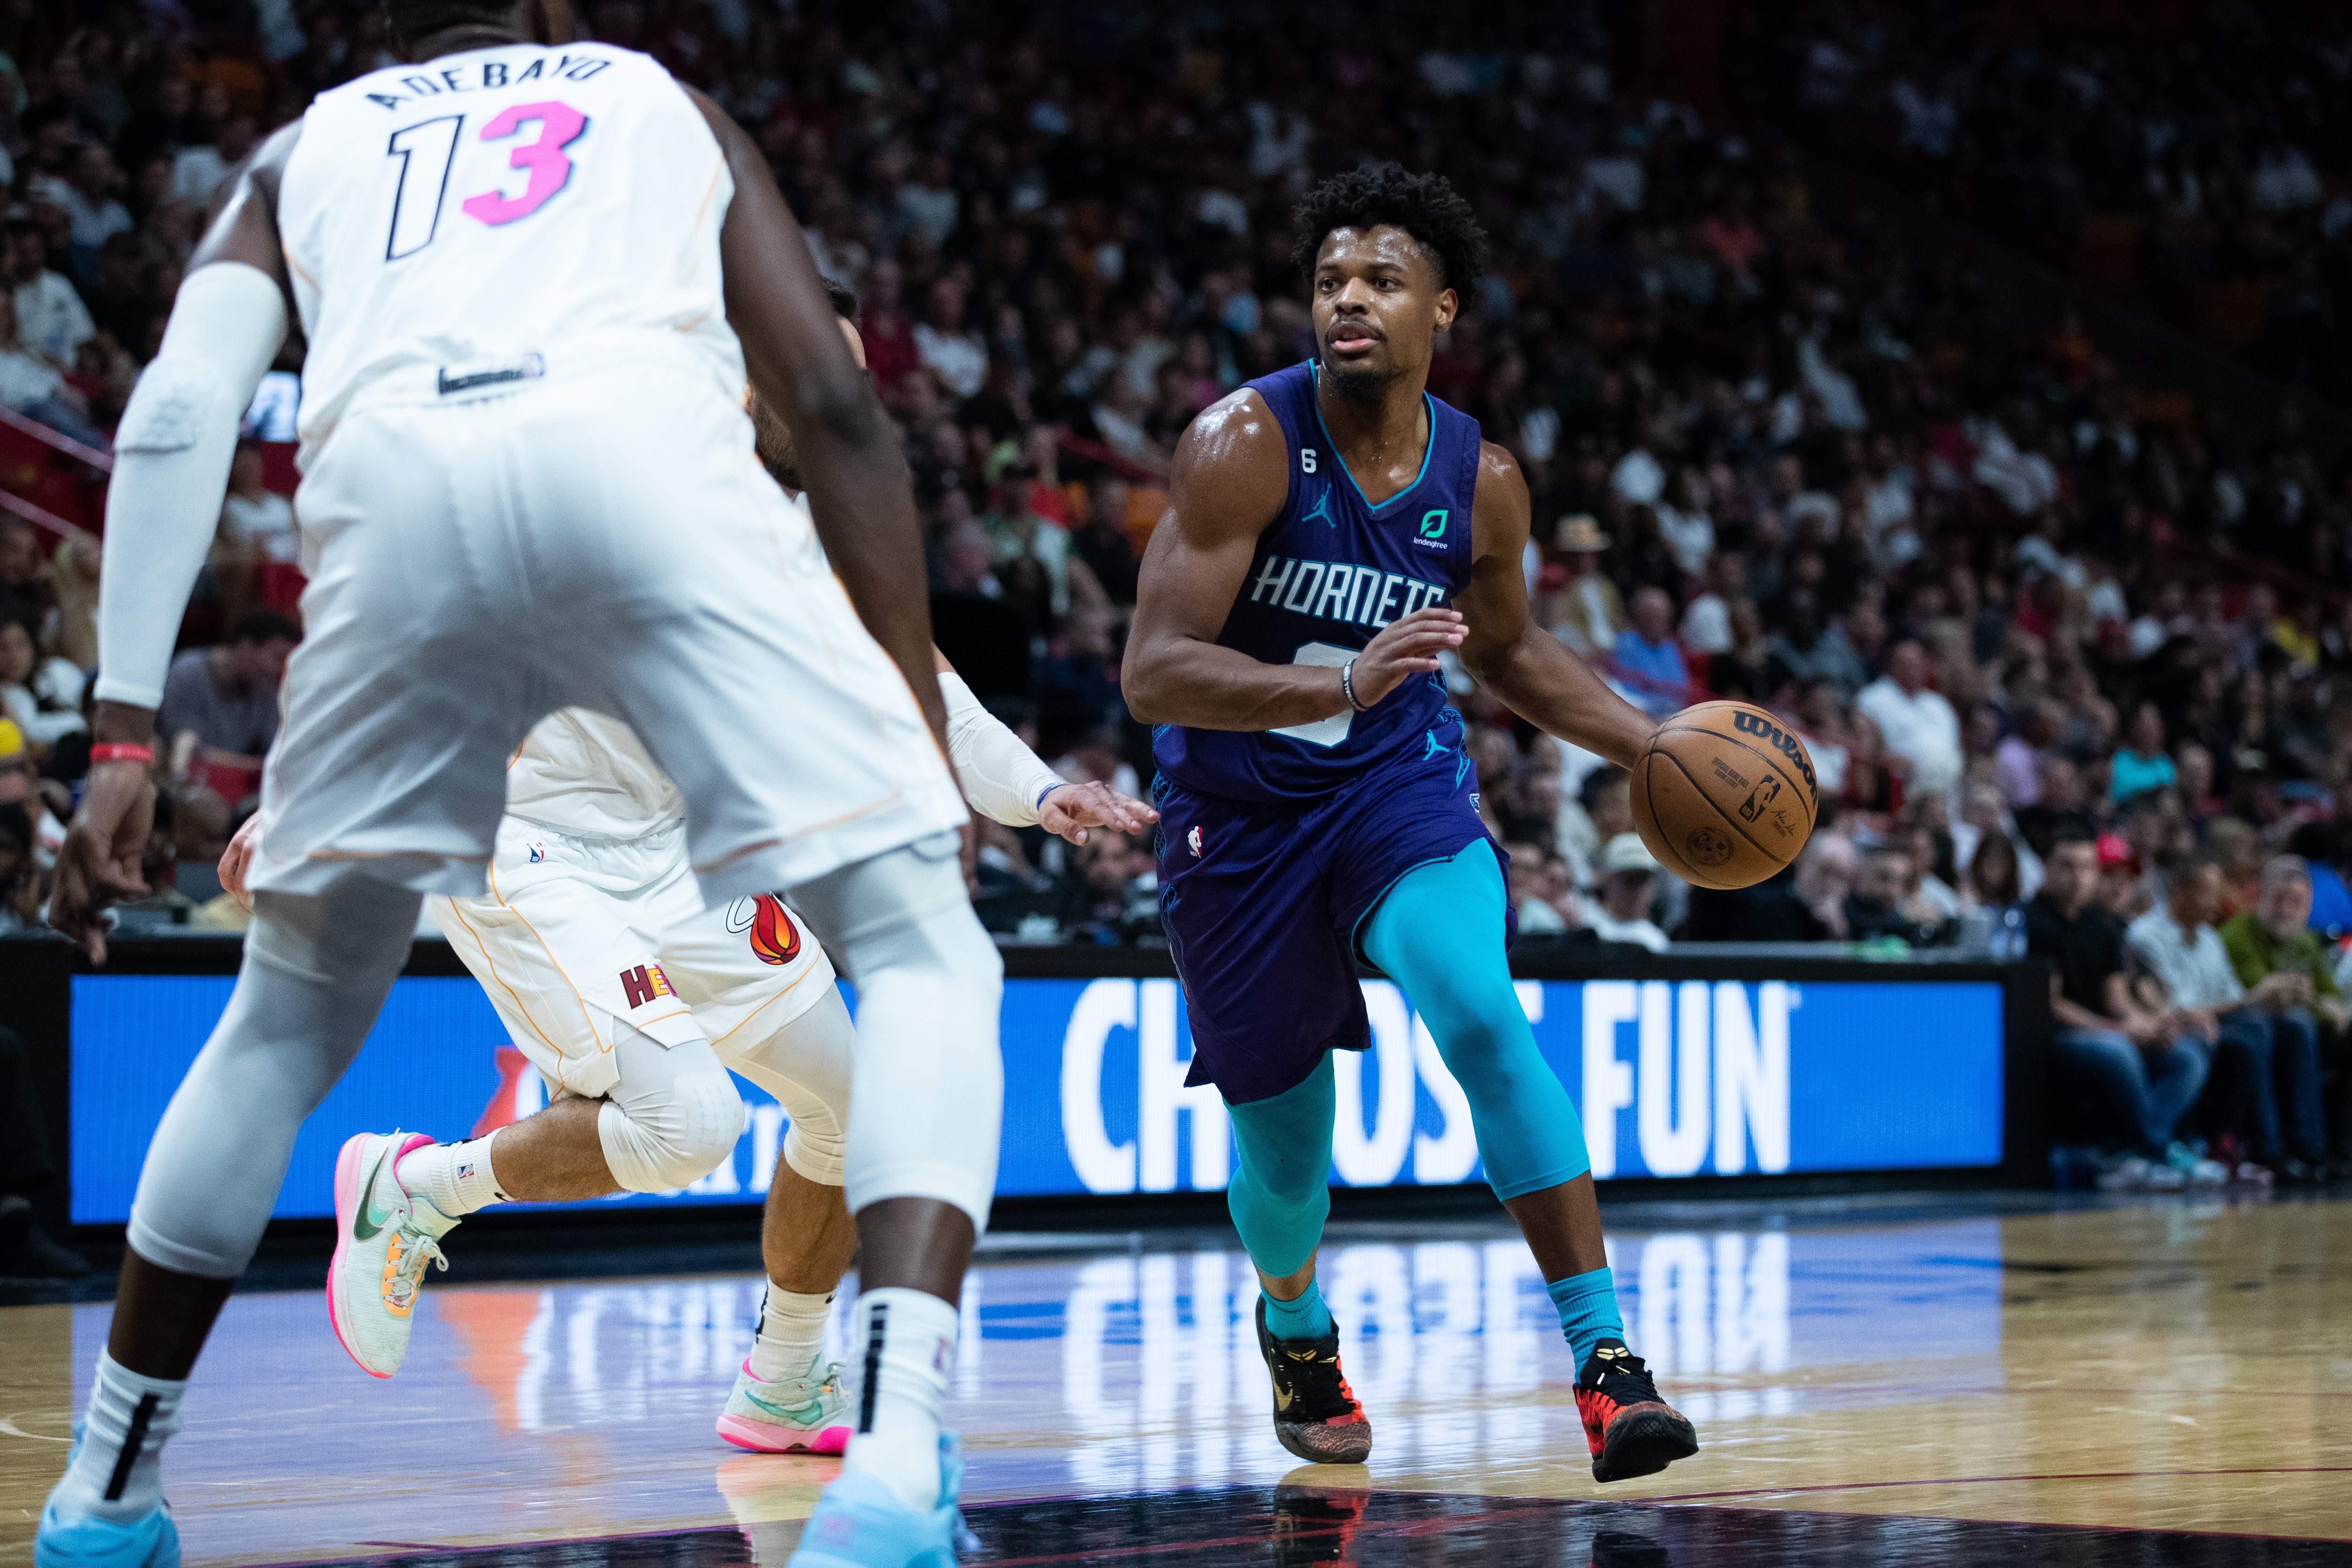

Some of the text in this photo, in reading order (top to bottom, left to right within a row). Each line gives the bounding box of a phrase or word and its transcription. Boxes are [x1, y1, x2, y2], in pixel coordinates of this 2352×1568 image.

[385, 100, 592, 263] 13
[1301, 448, 1317, 474] 6
[1414, 536, 1448, 550] lendingtree
[1728, 769, 1741, 782] GAME
[1737, 777, 1750, 789] BALL
[619, 964, 678, 1010] HE
[1061, 977, 1545, 1194] CHOS
[1583, 979, 1791, 1180] FUN
